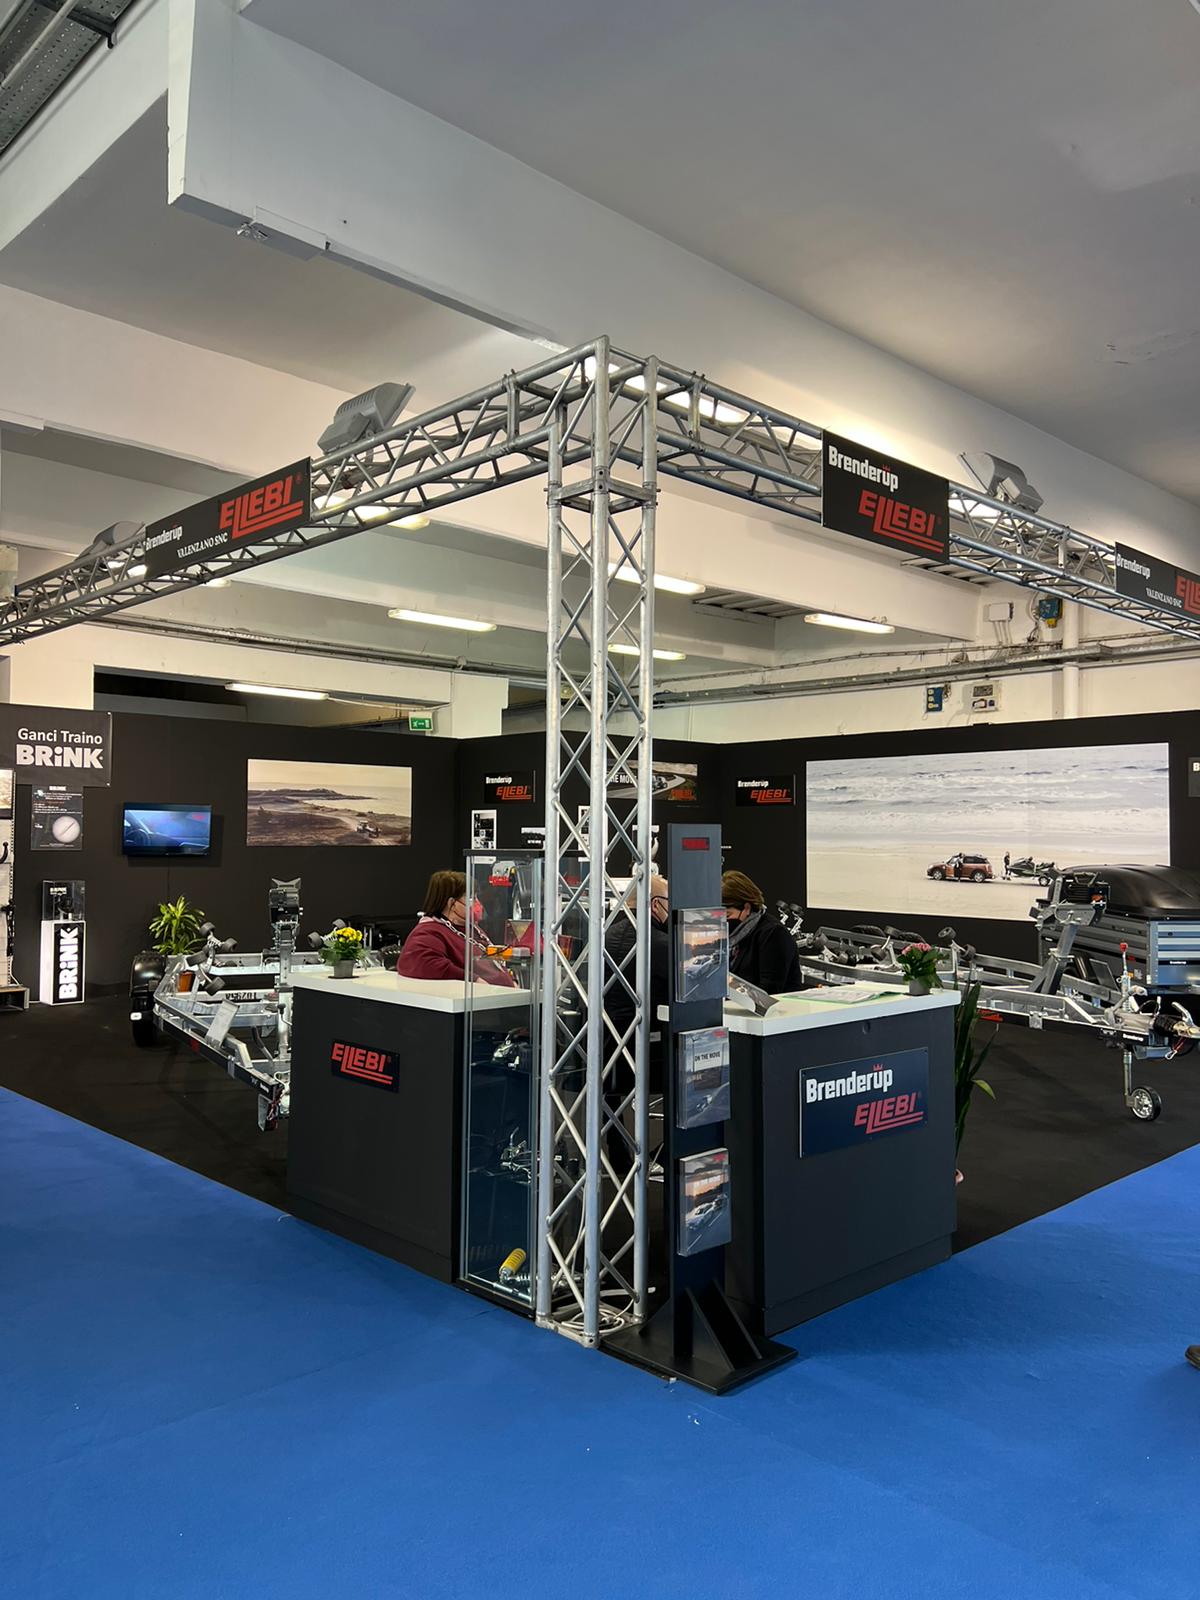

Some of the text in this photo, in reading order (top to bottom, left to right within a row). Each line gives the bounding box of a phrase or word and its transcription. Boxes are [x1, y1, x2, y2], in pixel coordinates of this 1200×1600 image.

[828, 445, 899, 493] Brenderup
[219, 475, 304, 540] ELLEBI
[858, 489, 945, 553] ELLEBI
[177, 532, 228, 559] VALENZANO SNC
[17, 727, 103, 745] Ganci Traino
[496, 785, 532, 801] ELLEBI
[750, 789, 792, 803] ELLEBI
[331, 1042, 394, 1085] ELLEBI
[806, 1069, 893, 1103] Brenderup
[854, 1092, 924, 1134] ELLEBI
